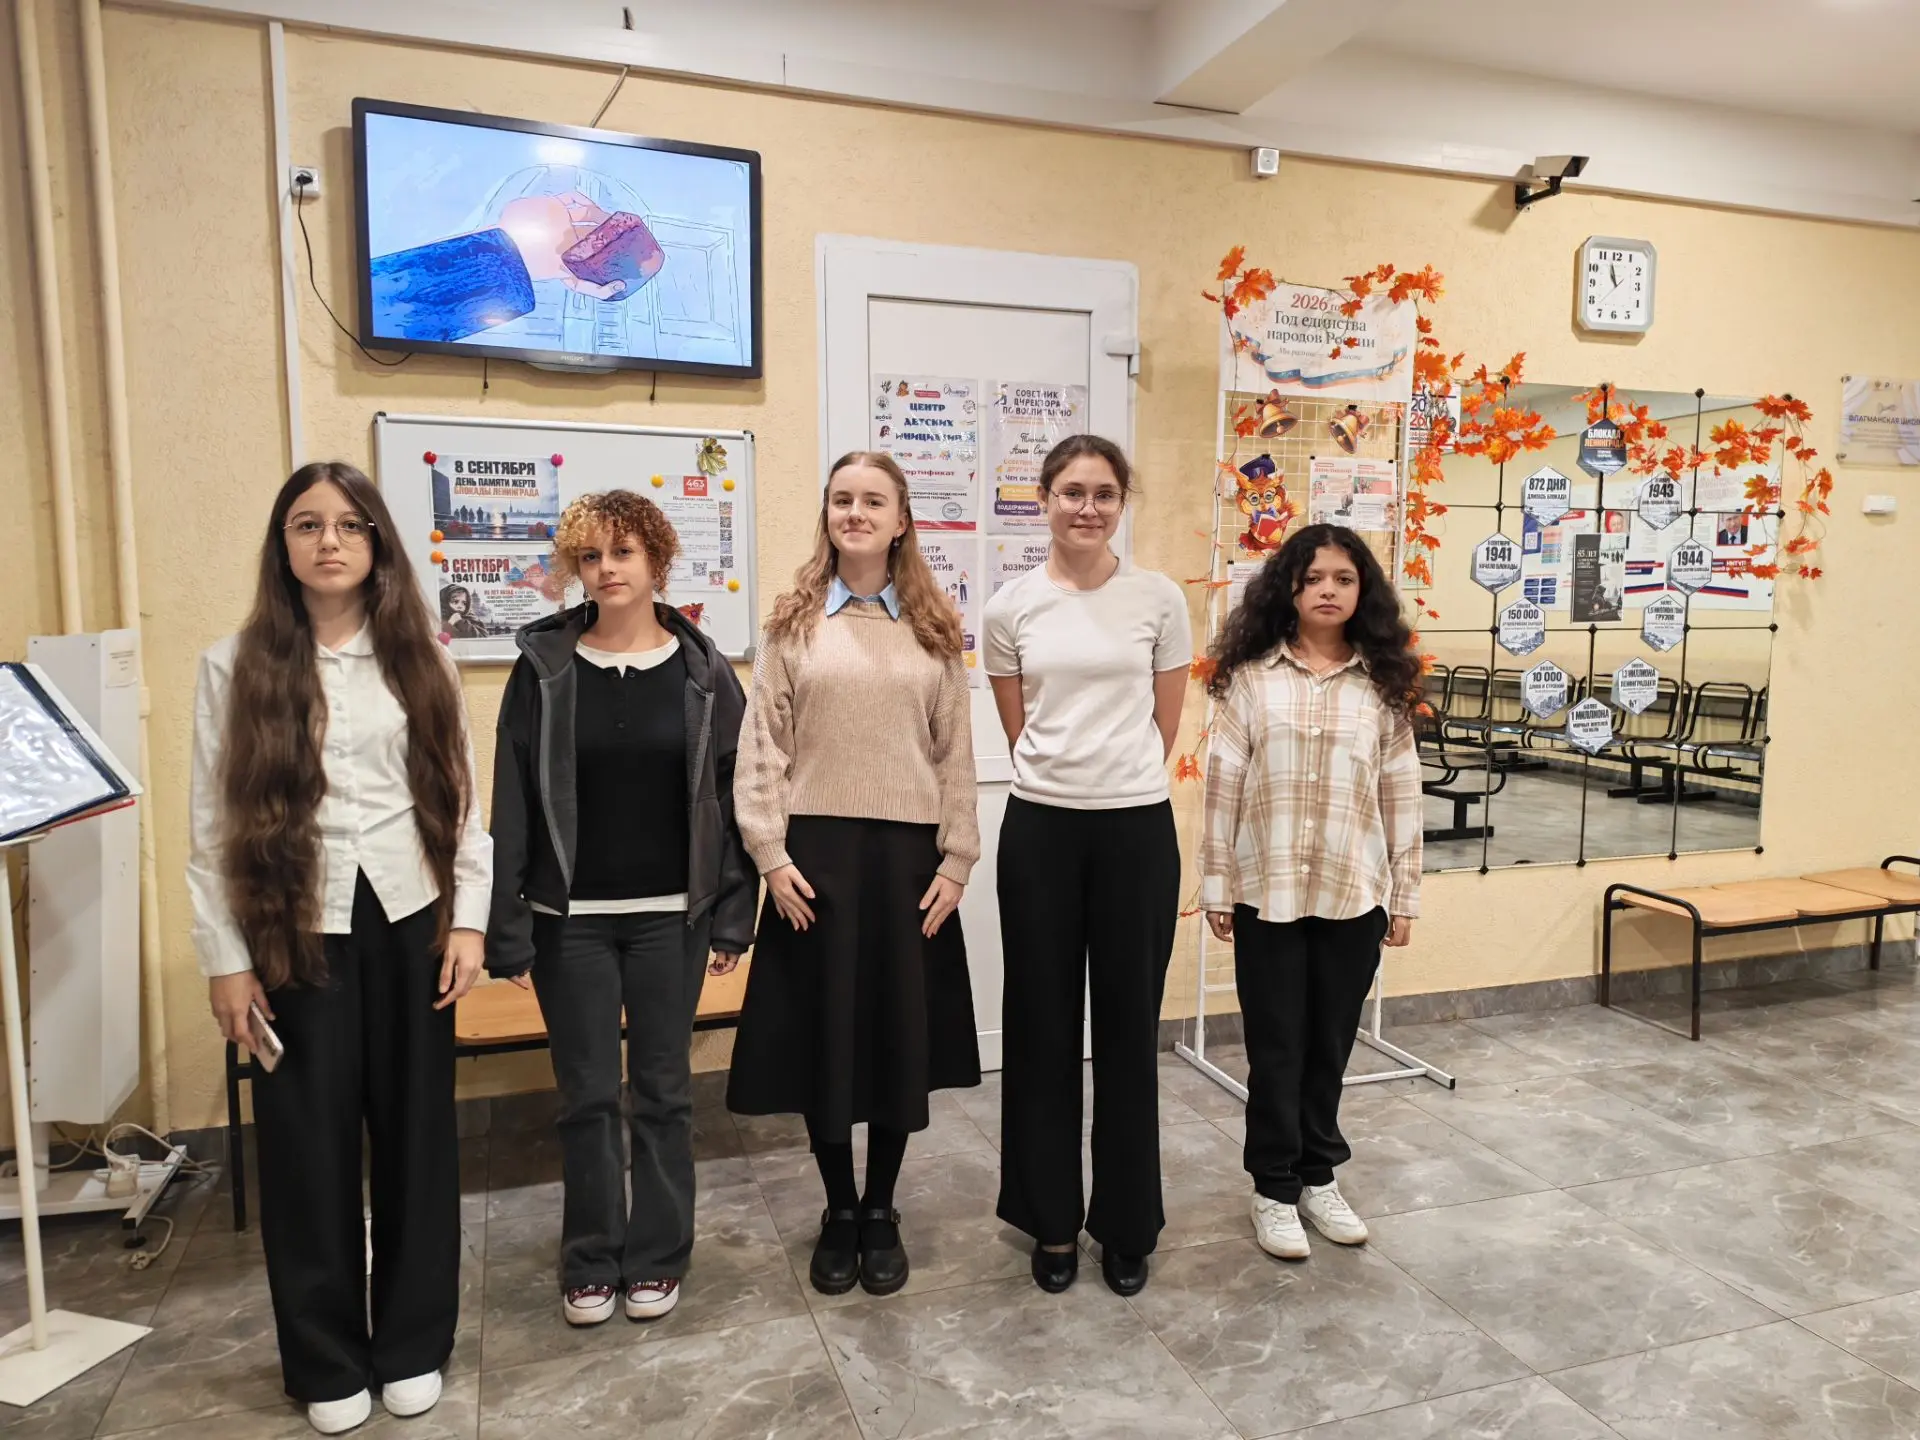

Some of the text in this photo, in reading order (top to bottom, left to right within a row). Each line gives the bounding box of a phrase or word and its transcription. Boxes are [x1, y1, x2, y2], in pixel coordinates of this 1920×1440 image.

[1600, 251, 1632, 262] 11 12 1
[1588, 264, 1598, 272] 10
[1636, 267, 1642, 276] 2
[1590, 278, 1596, 287] 9
[1634, 282, 1640, 292] 3
[1291, 292, 1328, 312] 2026
[1588, 296, 1595, 304] 8
[1597, 308, 1630, 320] 7 6 5
[1275, 310, 1367, 332] Год единства
[1267, 329, 1375, 348] народов Росии
[910, 403, 946, 412] ЦЕНТР
[1411, 398, 1426, 412] 20
[904, 418, 953, 427] ДЕТСКИХ
[1410, 412, 1427, 426] 26
[454, 460, 536, 475] 8 СЕНТЯБРЯ
[456, 478, 536, 488] ДЕНЬ ПАМЯТИ ЖЕРТВ
[686, 480, 704, 488] 463
[1529, 478, 1566, 491] 872 ДНЯ
[454, 486, 540, 496] БЛОКАДЫ ЛЕНИНГРАДА
[1649, 484, 1674, 498] 1943
[1486, 546, 1512, 561] 1941
[1678, 550, 1704, 566] 1944
[442, 558, 510, 573] 8 СЕНТЯБРЯ
[451, 573, 501, 583] 1941 ГОДА
[1508, 610, 1538, 619] 150 000
[1533, 672, 1562, 682] 10 000
[1576, 710, 1609, 720] МИЛЛИОНА
